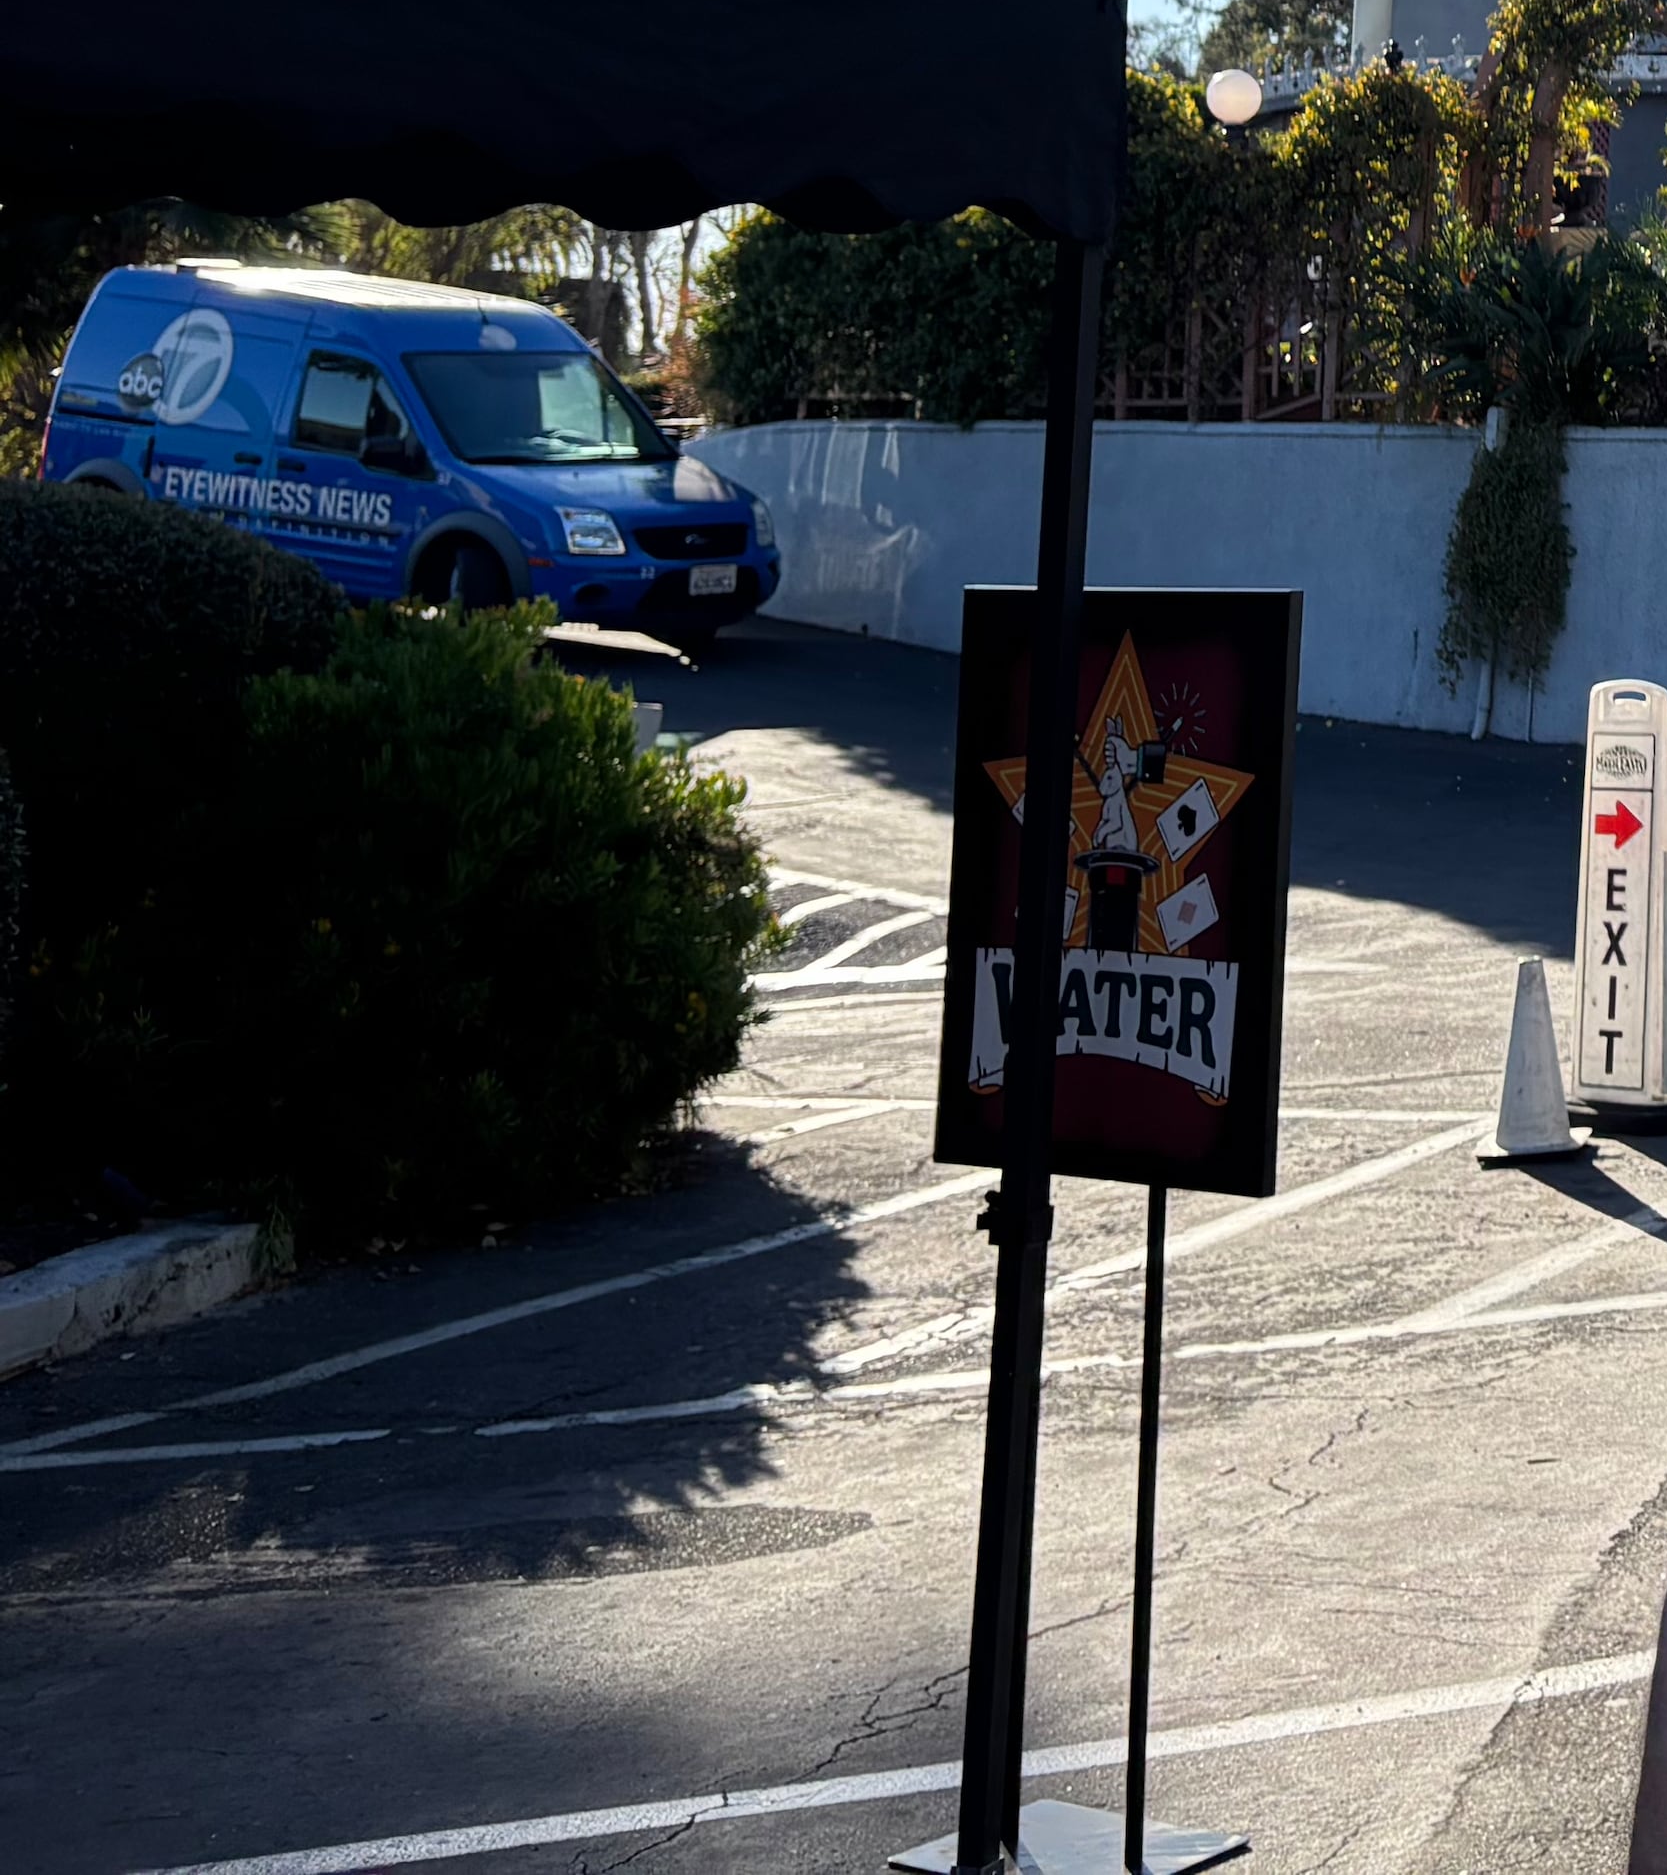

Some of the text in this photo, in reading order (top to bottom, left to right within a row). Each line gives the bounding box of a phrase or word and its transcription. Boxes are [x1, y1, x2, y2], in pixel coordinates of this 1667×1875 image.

[119, 366, 163, 397] abc
[164, 466, 312, 517] EYEWITNESS
[317, 486, 392, 527] NEWS
[1598, 868, 1627, 1075] EXIT
